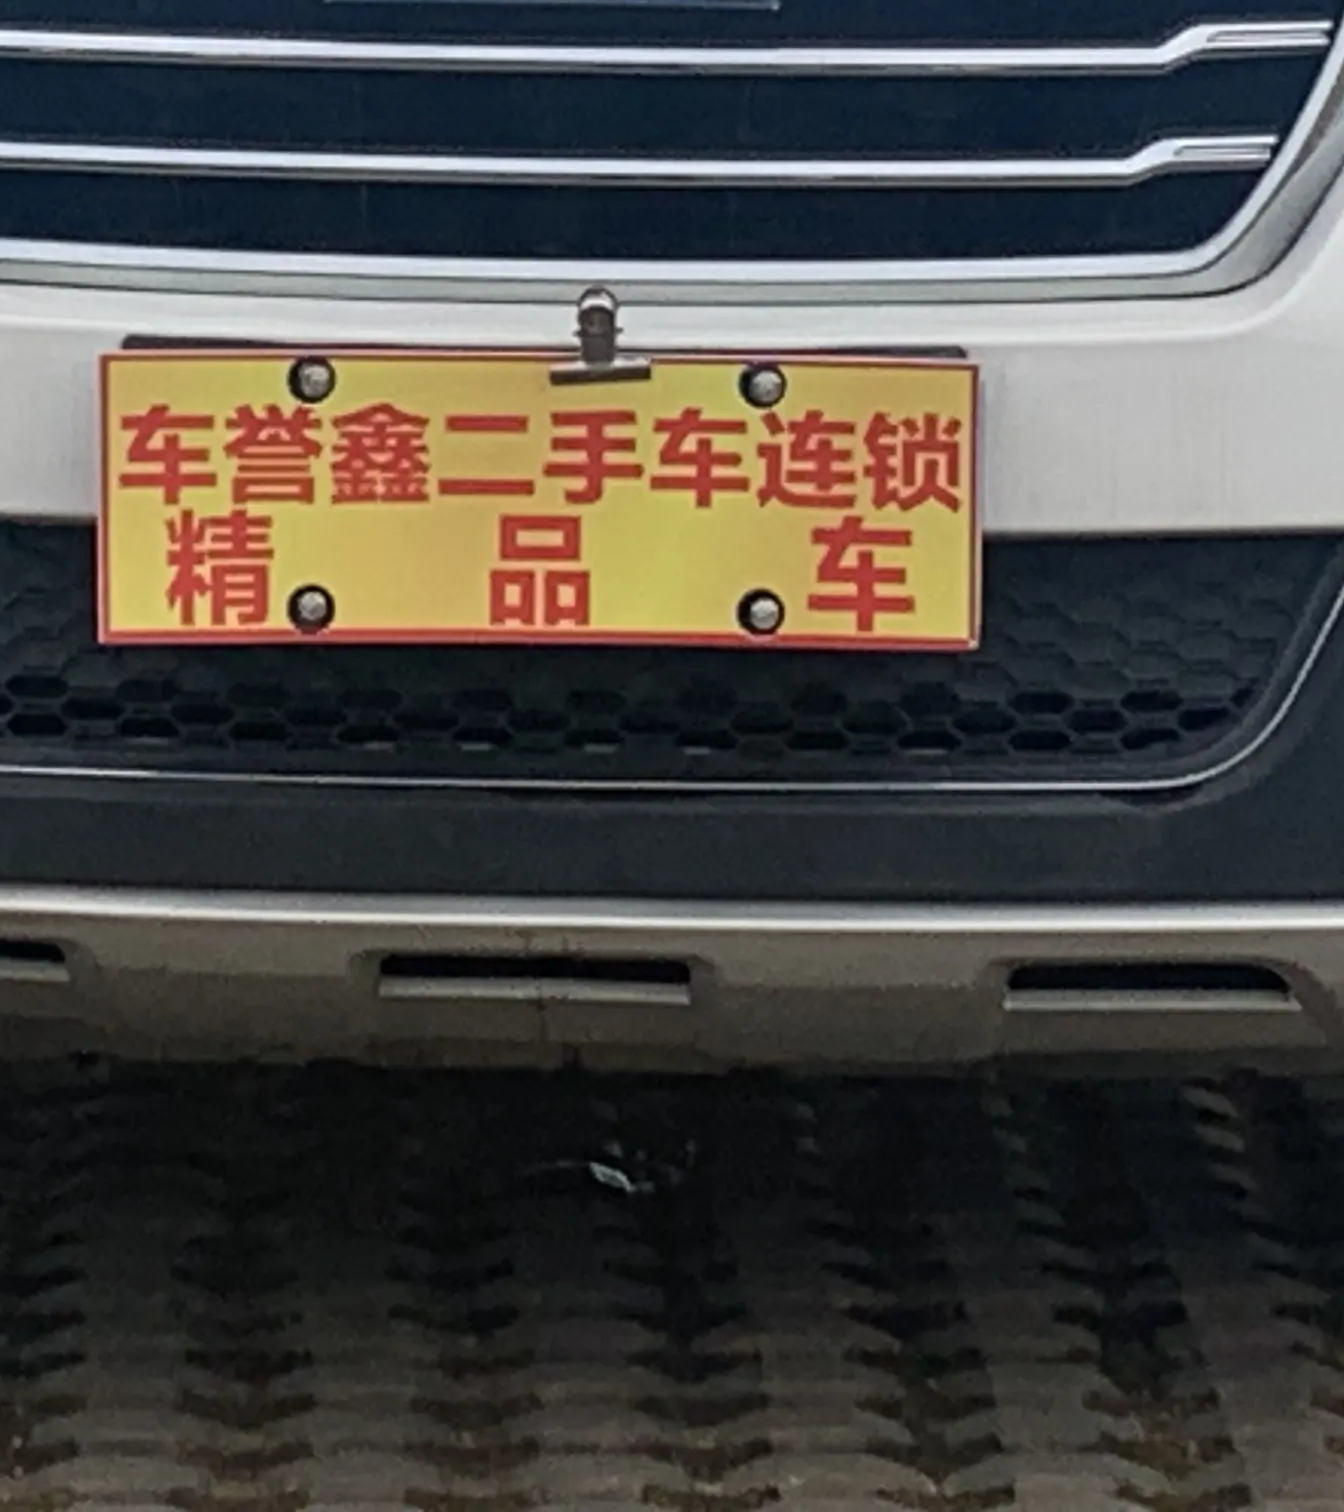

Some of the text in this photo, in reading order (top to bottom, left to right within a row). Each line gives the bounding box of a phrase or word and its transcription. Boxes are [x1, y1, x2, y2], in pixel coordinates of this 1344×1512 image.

[118, 402, 962, 513] 车誉鑫二手车连锁
